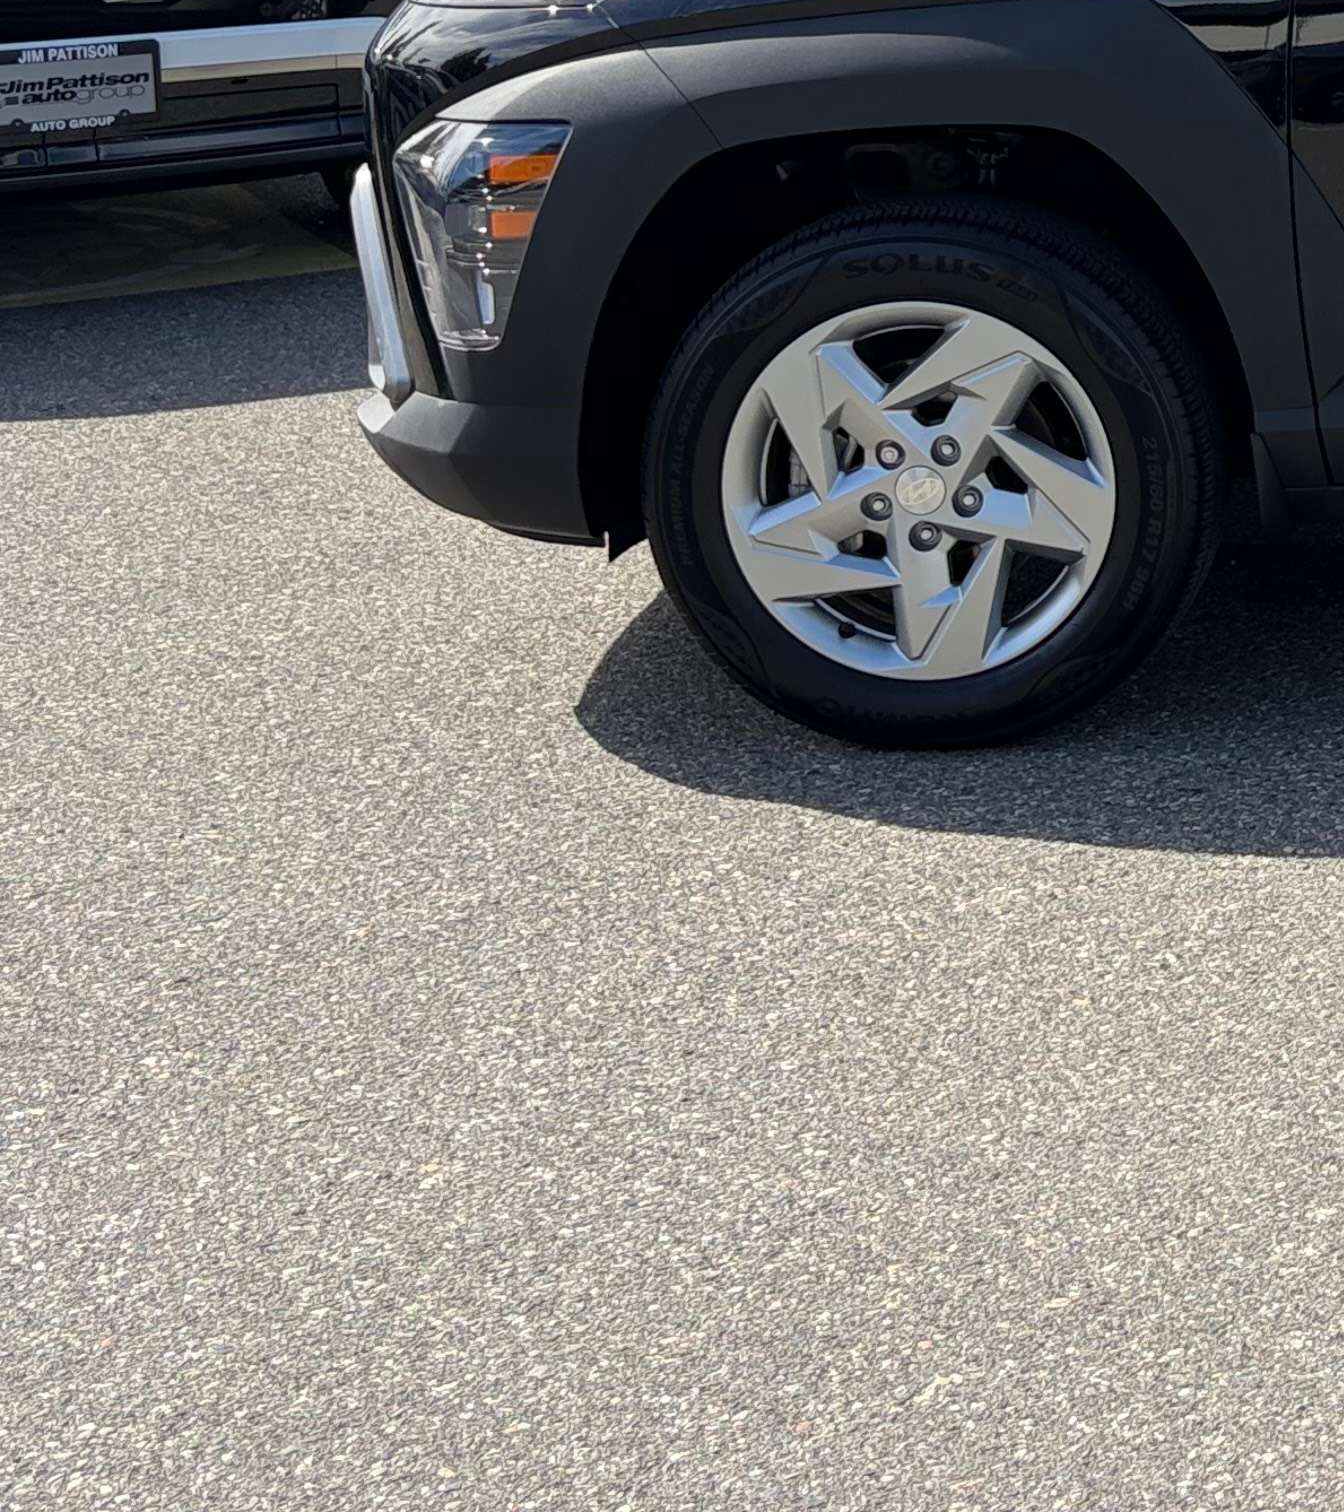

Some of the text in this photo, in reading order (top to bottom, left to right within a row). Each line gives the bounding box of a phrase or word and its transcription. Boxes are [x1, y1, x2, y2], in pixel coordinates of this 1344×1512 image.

[18, 43, 119, 64] JIM PATTISON
[31, 115, 116, 132] AUTO GROUP
[842, 252, 993, 282] SOLUS
